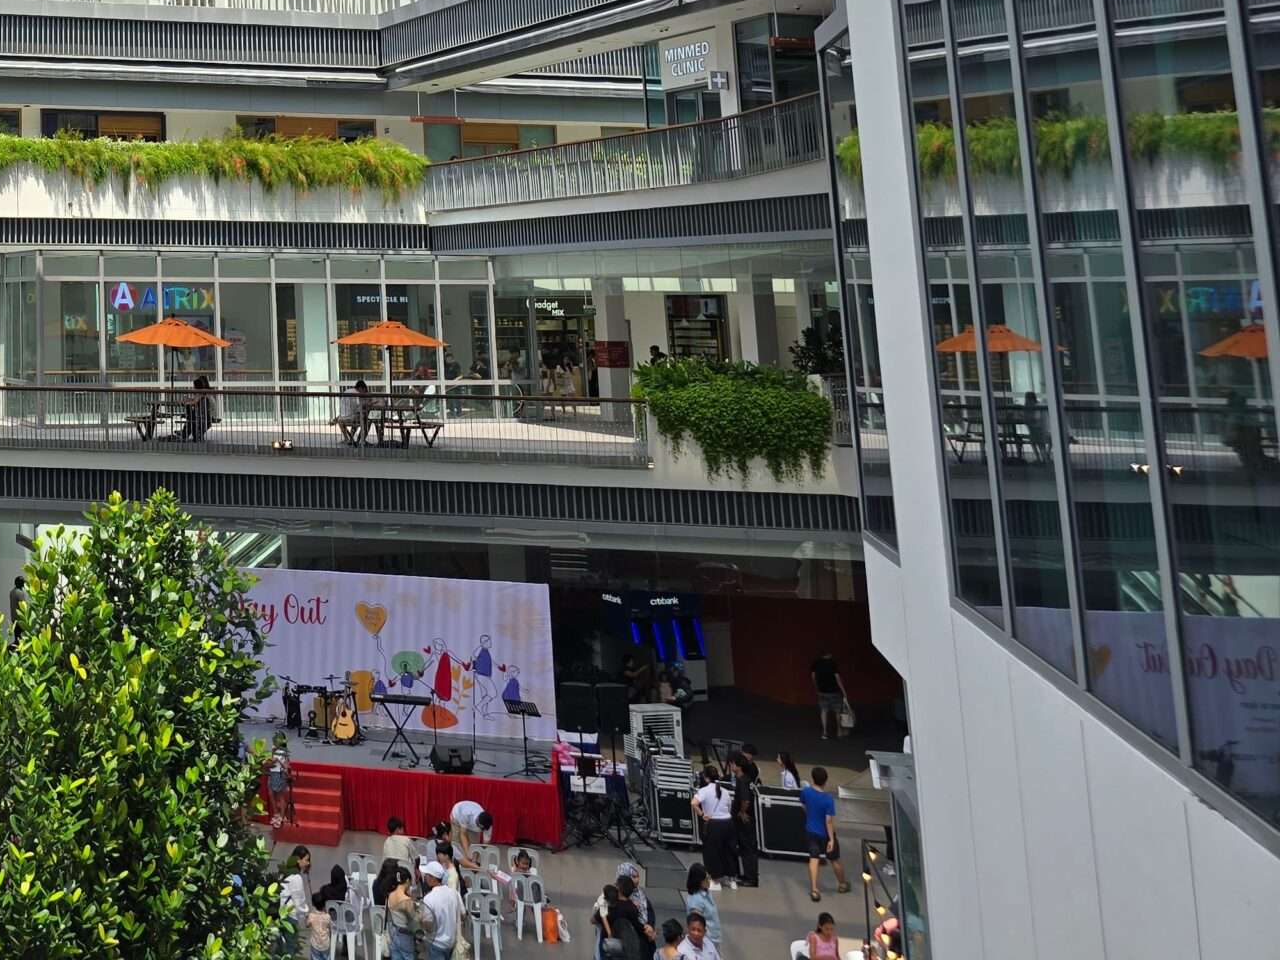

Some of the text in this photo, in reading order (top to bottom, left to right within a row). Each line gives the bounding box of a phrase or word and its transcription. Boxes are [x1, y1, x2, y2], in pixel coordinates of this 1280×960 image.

[664, 41, 710, 64] MINMED
[671, 57, 706, 77] CLINIC
[356, 295, 399, 304] SPECTCLE
[283, 592, 329, 626] Out
